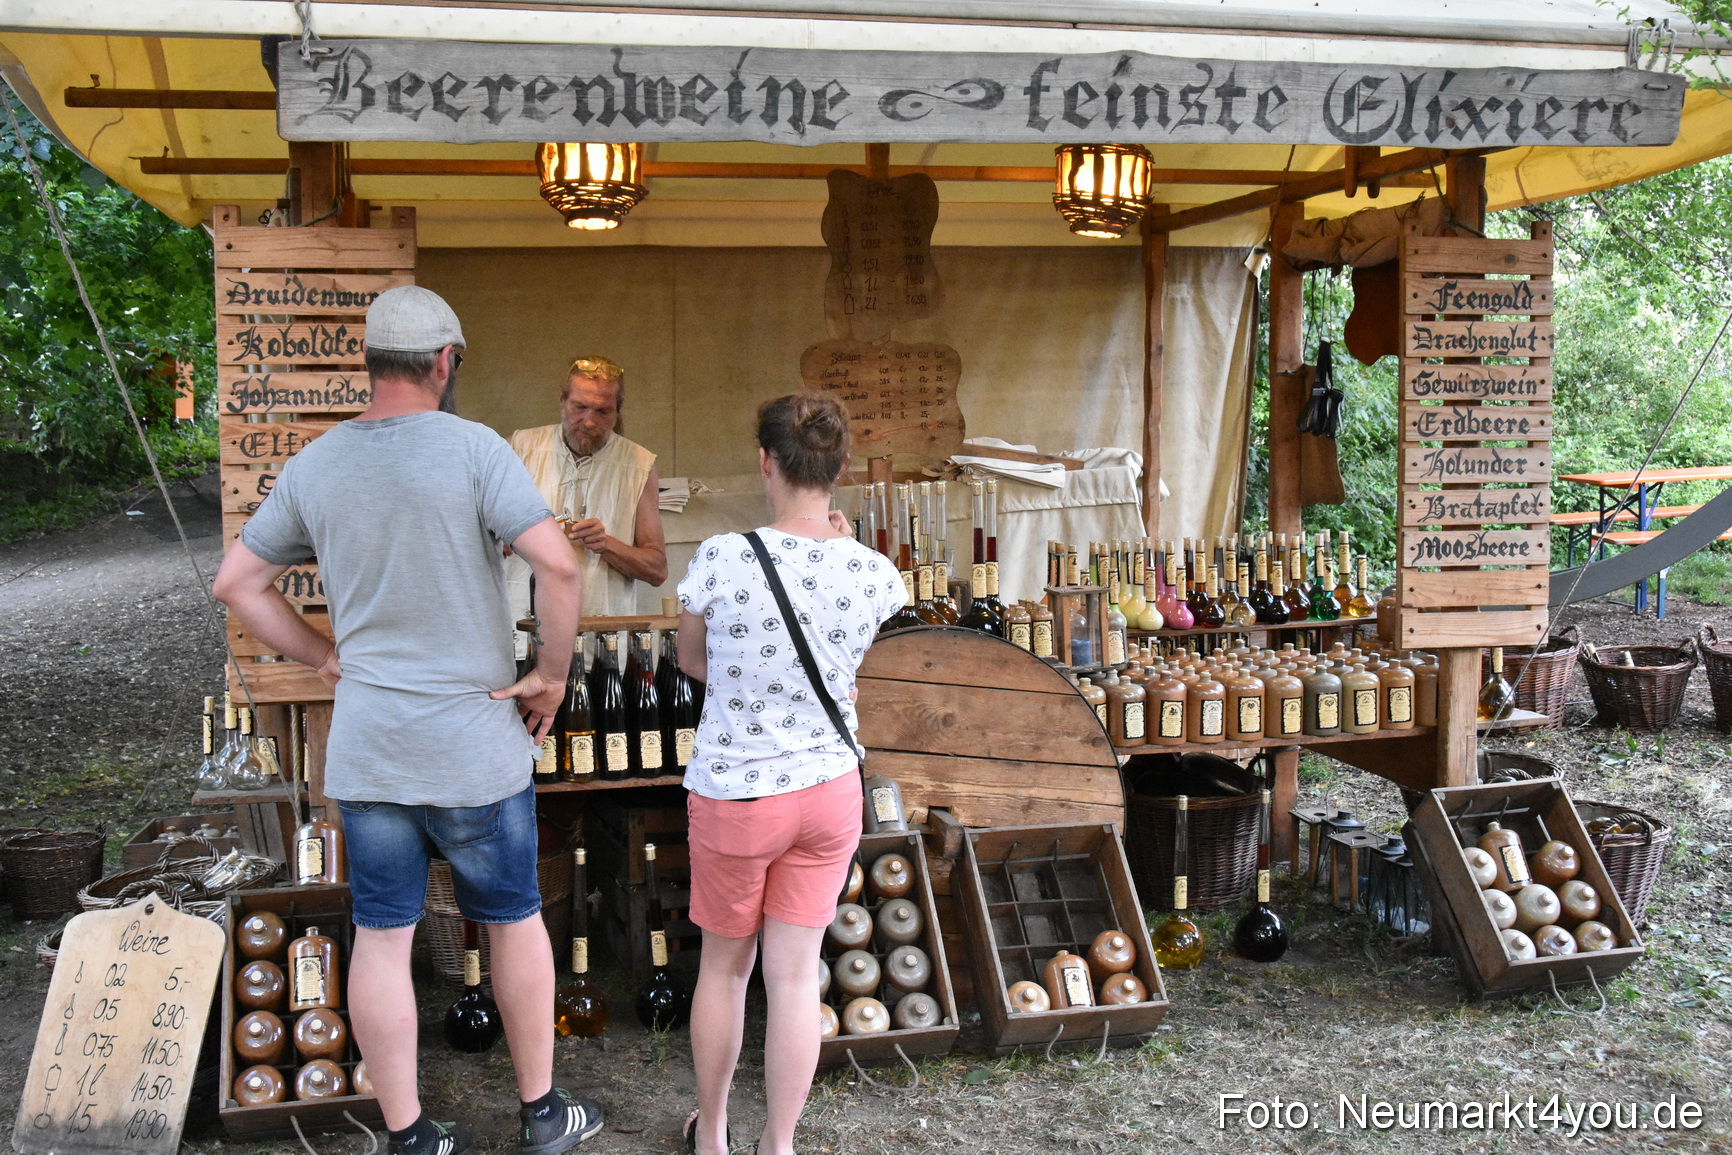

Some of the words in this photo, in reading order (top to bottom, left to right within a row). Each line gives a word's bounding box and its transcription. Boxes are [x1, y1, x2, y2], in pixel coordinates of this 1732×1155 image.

[303, 46, 854, 131] Beerenweine
[1023, 54, 1289, 134] feinste
[1322, 70, 1649, 147] Elixiere
[226, 275, 385, 307] Druidenwur
[1425, 280, 1535, 314] Feengold
[1413, 321, 1538, 356] Drachenglut
[1413, 369, 1538, 397] Gewürzwein
[1417, 406, 1531, 437] Erdbeere
[1420, 448, 1528, 482] Holunder
[1417, 491, 1543, 523] Bratapfel
[1412, 531, 1531, 566] Moosbeere
[118, 919, 172, 956] Weine
[164, 966, 191, 994] 5,-
[93, 997, 122, 1023] 0,5
[83, 1031, 119, 1059] 0,75
